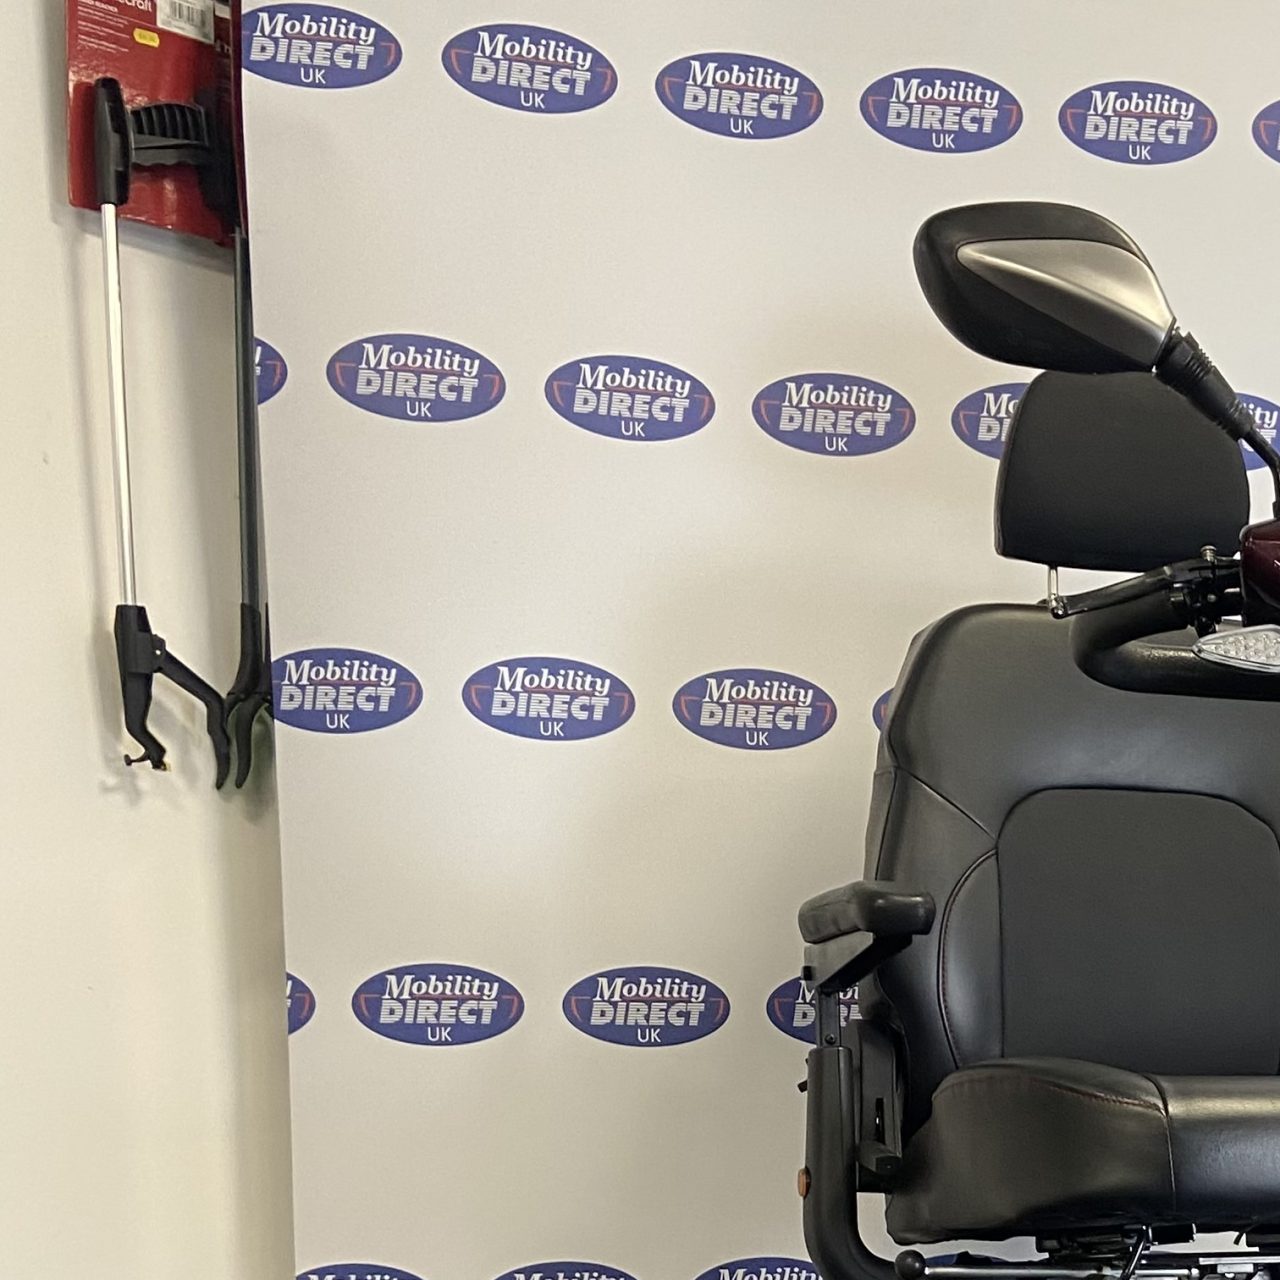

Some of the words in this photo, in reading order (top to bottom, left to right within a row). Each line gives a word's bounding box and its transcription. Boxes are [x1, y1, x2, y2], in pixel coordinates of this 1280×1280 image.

[253, 11, 376, 45] Mobility
[249, 36, 374, 70] DIRECT
[474, 30, 593, 70] Mobility
[300, 68, 327, 84] UK
[470, 56, 591, 96] DIRECT
[685, 60, 799, 95] Mobility
[520, 91, 546, 109] UK
[682, 85, 798, 121] DIRECT
[889, 77, 1000, 108] Mobility
[1087, 90, 1195, 120] Mobility
[730, 118, 754, 134] UK
[886, 102, 998, 133] DIRECT
[1084, 115, 1193, 145] DIRECT
[932, 133, 956, 149] UK
[1128, 145, 1152, 160] UK
[358, 342, 480, 377] Mobility
[355, 369, 479, 403] DIRECT
[575, 363, 691, 398] Mobility
[406, 401, 432, 418] UK
[572, 388, 690, 423] DIRECT
[782, 382, 892, 412] Mobility
[620, 420, 645, 437] UK
[779, 407, 891, 436] DIRECT
[825, 436, 849, 451] UK
[280, 659, 396, 687] Mobility
[493, 666, 611, 696] Mobility
[278, 685, 395, 712] DIRECT
[490, 691, 609, 721] DIRECT
[702, 678, 814, 707] Mobility
[326, 713, 351, 729] UK
[539, 721, 564, 736] UK
[699, 702, 812, 731] DIRECT
[745, 731, 769, 746] UK
[382, 974, 499, 1000] Mobility
[593, 977, 707, 1003] Mobility
[379, 999, 497, 1024] DIRECT
[590, 1002, 705, 1026] DIRECT
[427, 1026, 453, 1042] UK
[637, 1028, 661, 1043] UK
